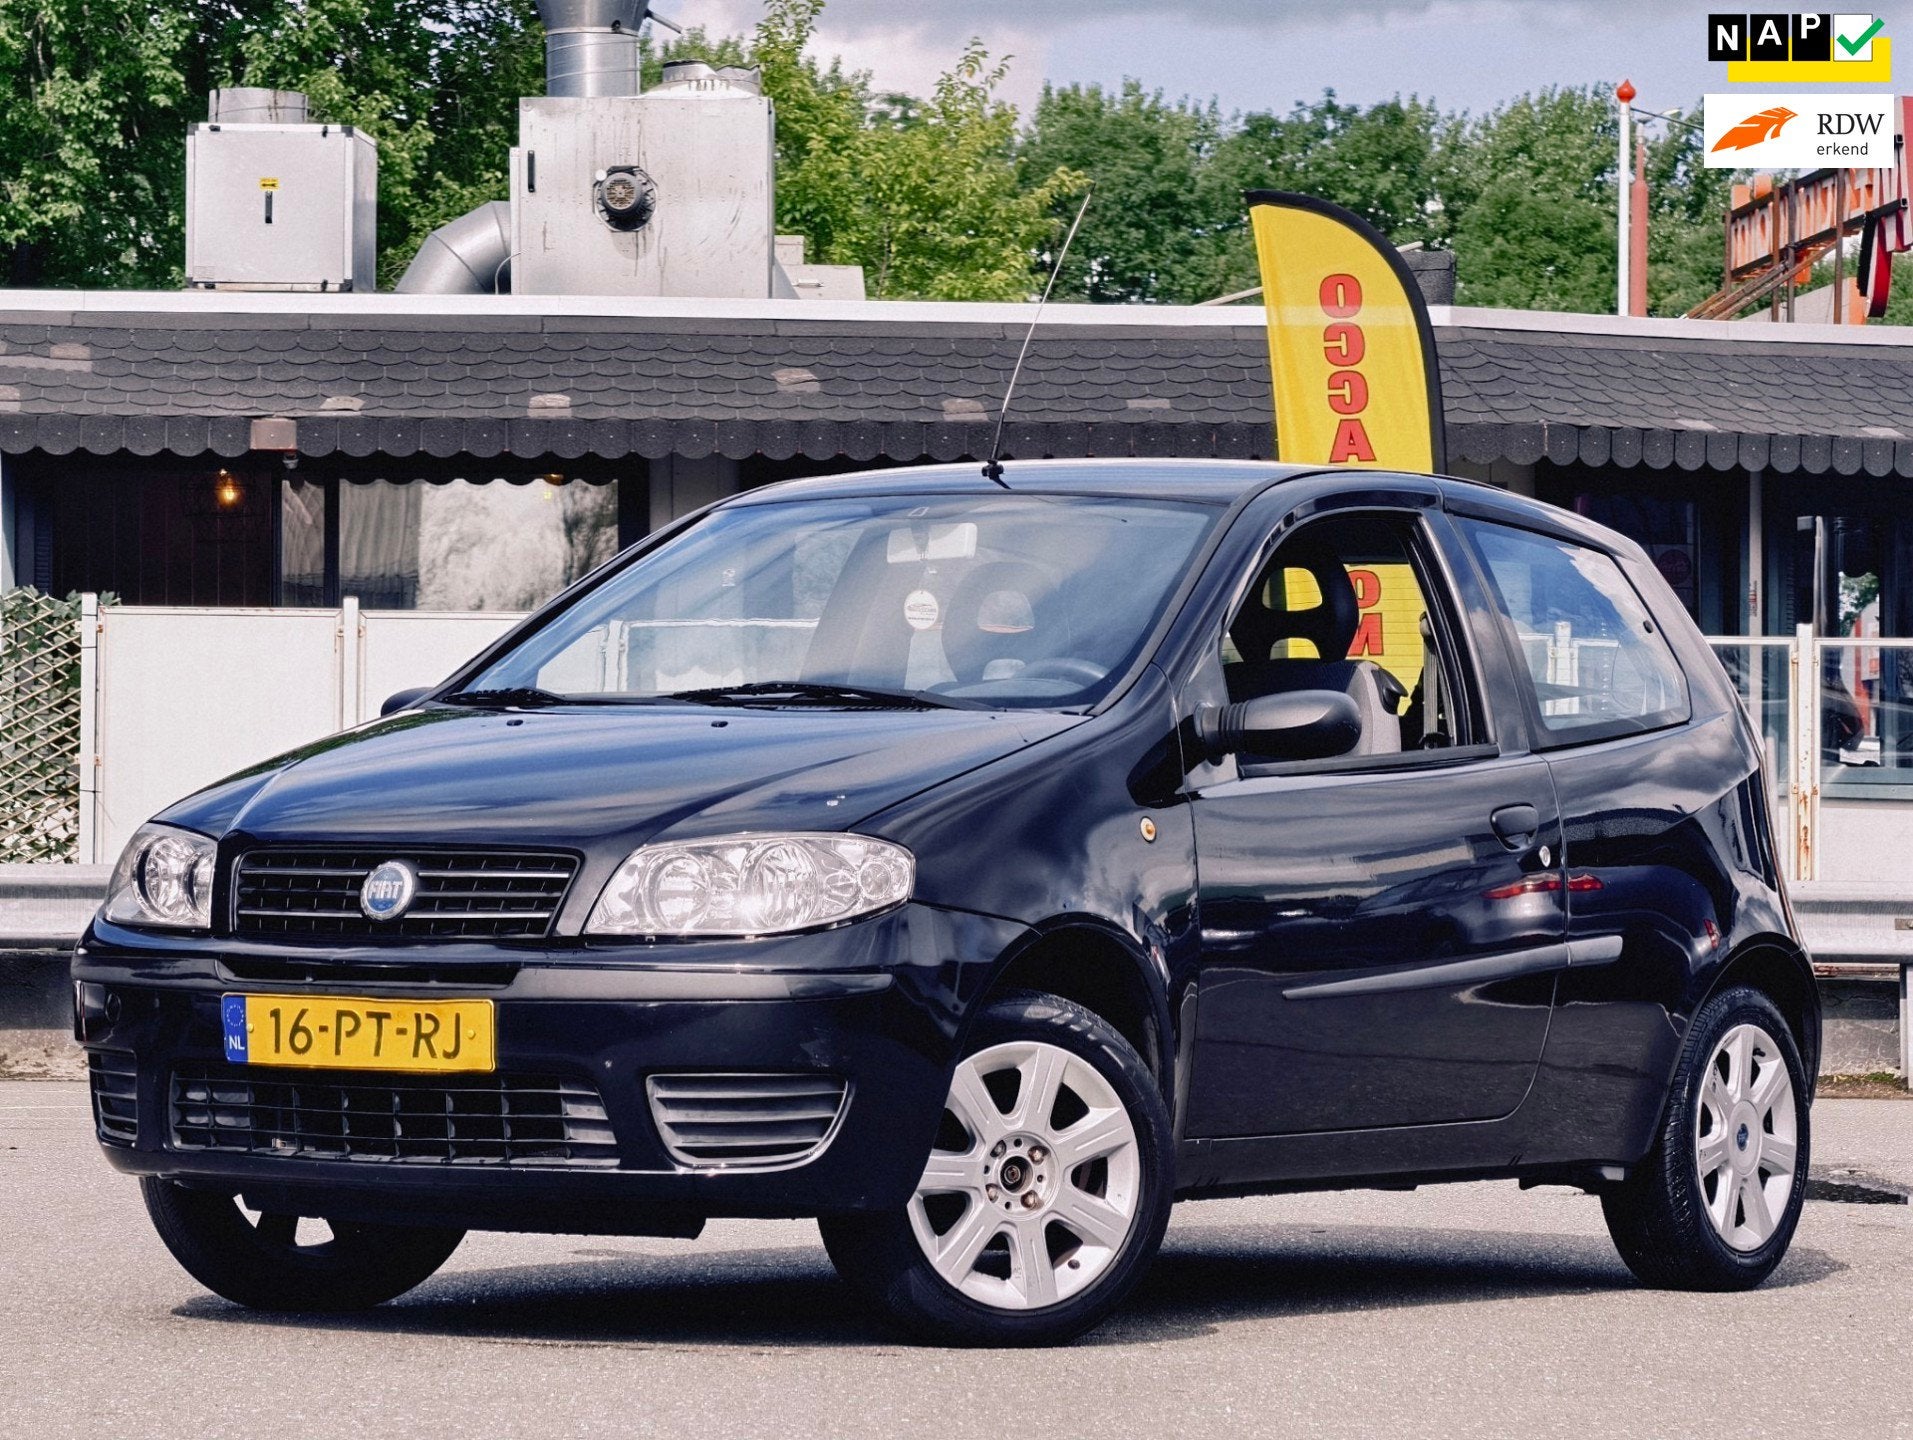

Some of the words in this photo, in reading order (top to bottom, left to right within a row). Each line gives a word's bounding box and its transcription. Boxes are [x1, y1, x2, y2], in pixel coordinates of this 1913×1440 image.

[368, 880, 403, 899] FIAT
[228, 1034, 245, 1051] NL
[269, 1007, 461, 1060] 16-PT-RJ
